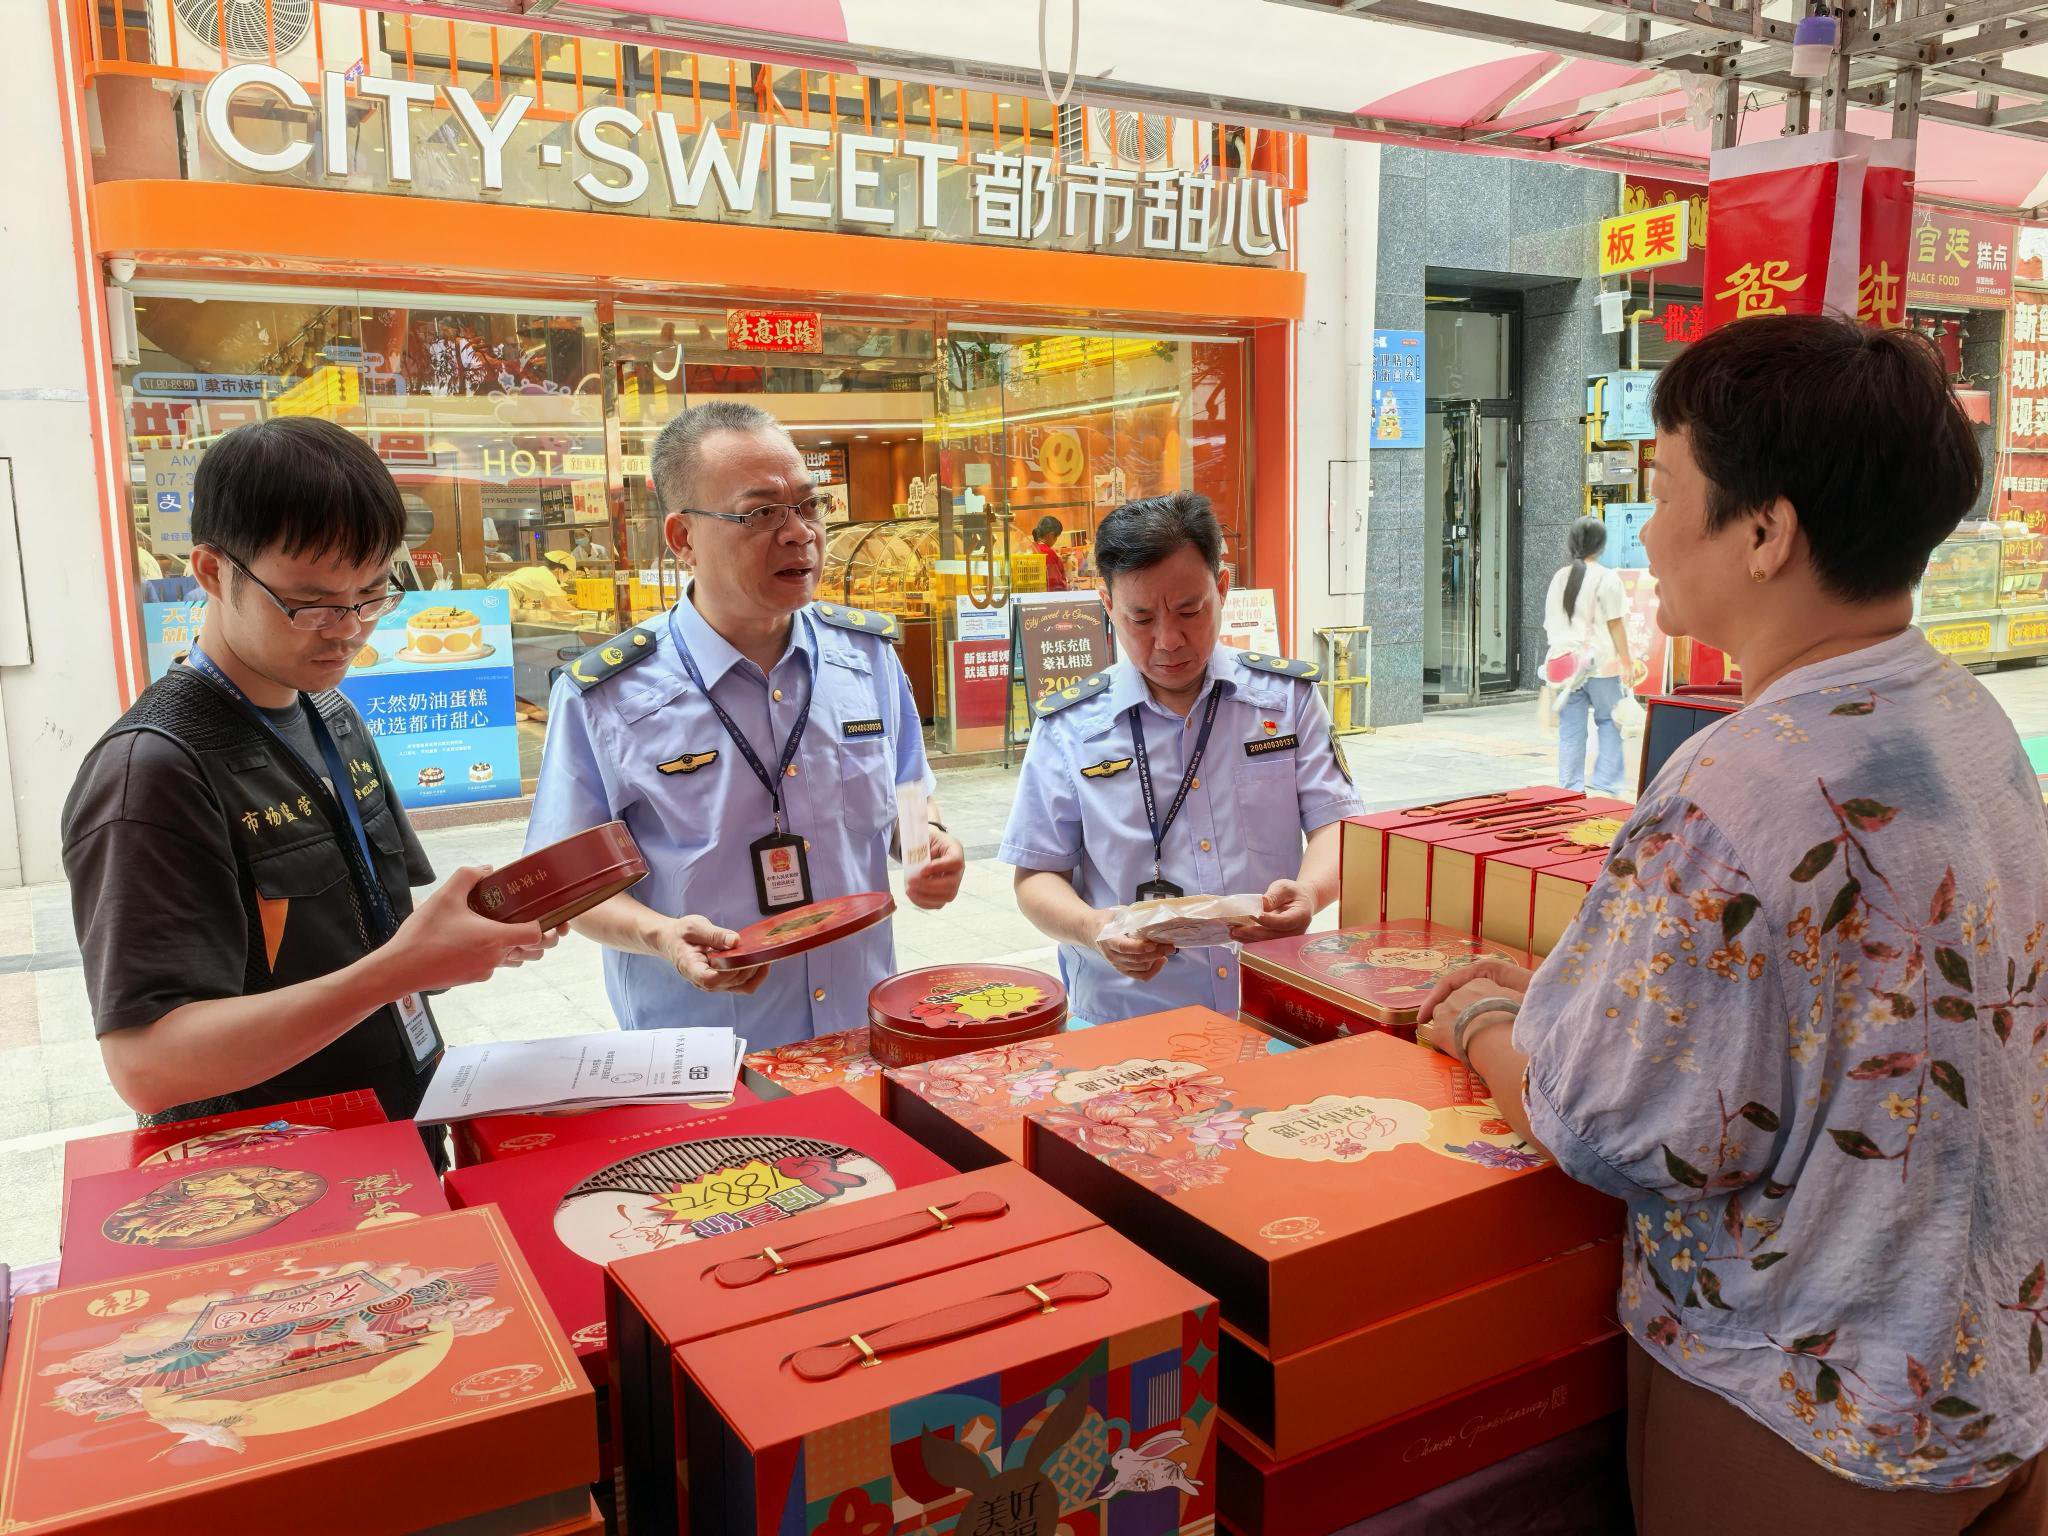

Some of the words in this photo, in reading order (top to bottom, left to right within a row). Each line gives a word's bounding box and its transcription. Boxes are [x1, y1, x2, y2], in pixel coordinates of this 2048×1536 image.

[971, 150, 1288, 257] 都市甜心
[1607, 213, 1676, 266] 板栗
[1915, 223, 1970, 268] 宫廷
[1977, 241, 2008, 271] 糕点
[1907, 271, 1936, 284] PALACE
[1938, 274, 1960, 287] FOOD
[1857, 261, 1901, 330] 纯
[733, 317, 815, 345] 生意興隆
[170, 455, 197, 467] AM
[483, 449, 557, 477] HOT
[1040, 638, 1091, 655] 快乐充值
[1041, 653, 1093, 670] 豪礼相送
[366, 689, 489, 715] 天然奶油蛋糕
[366, 708, 490, 737] 就选都市甜心
[242, 795, 313, 836] 市场监管
